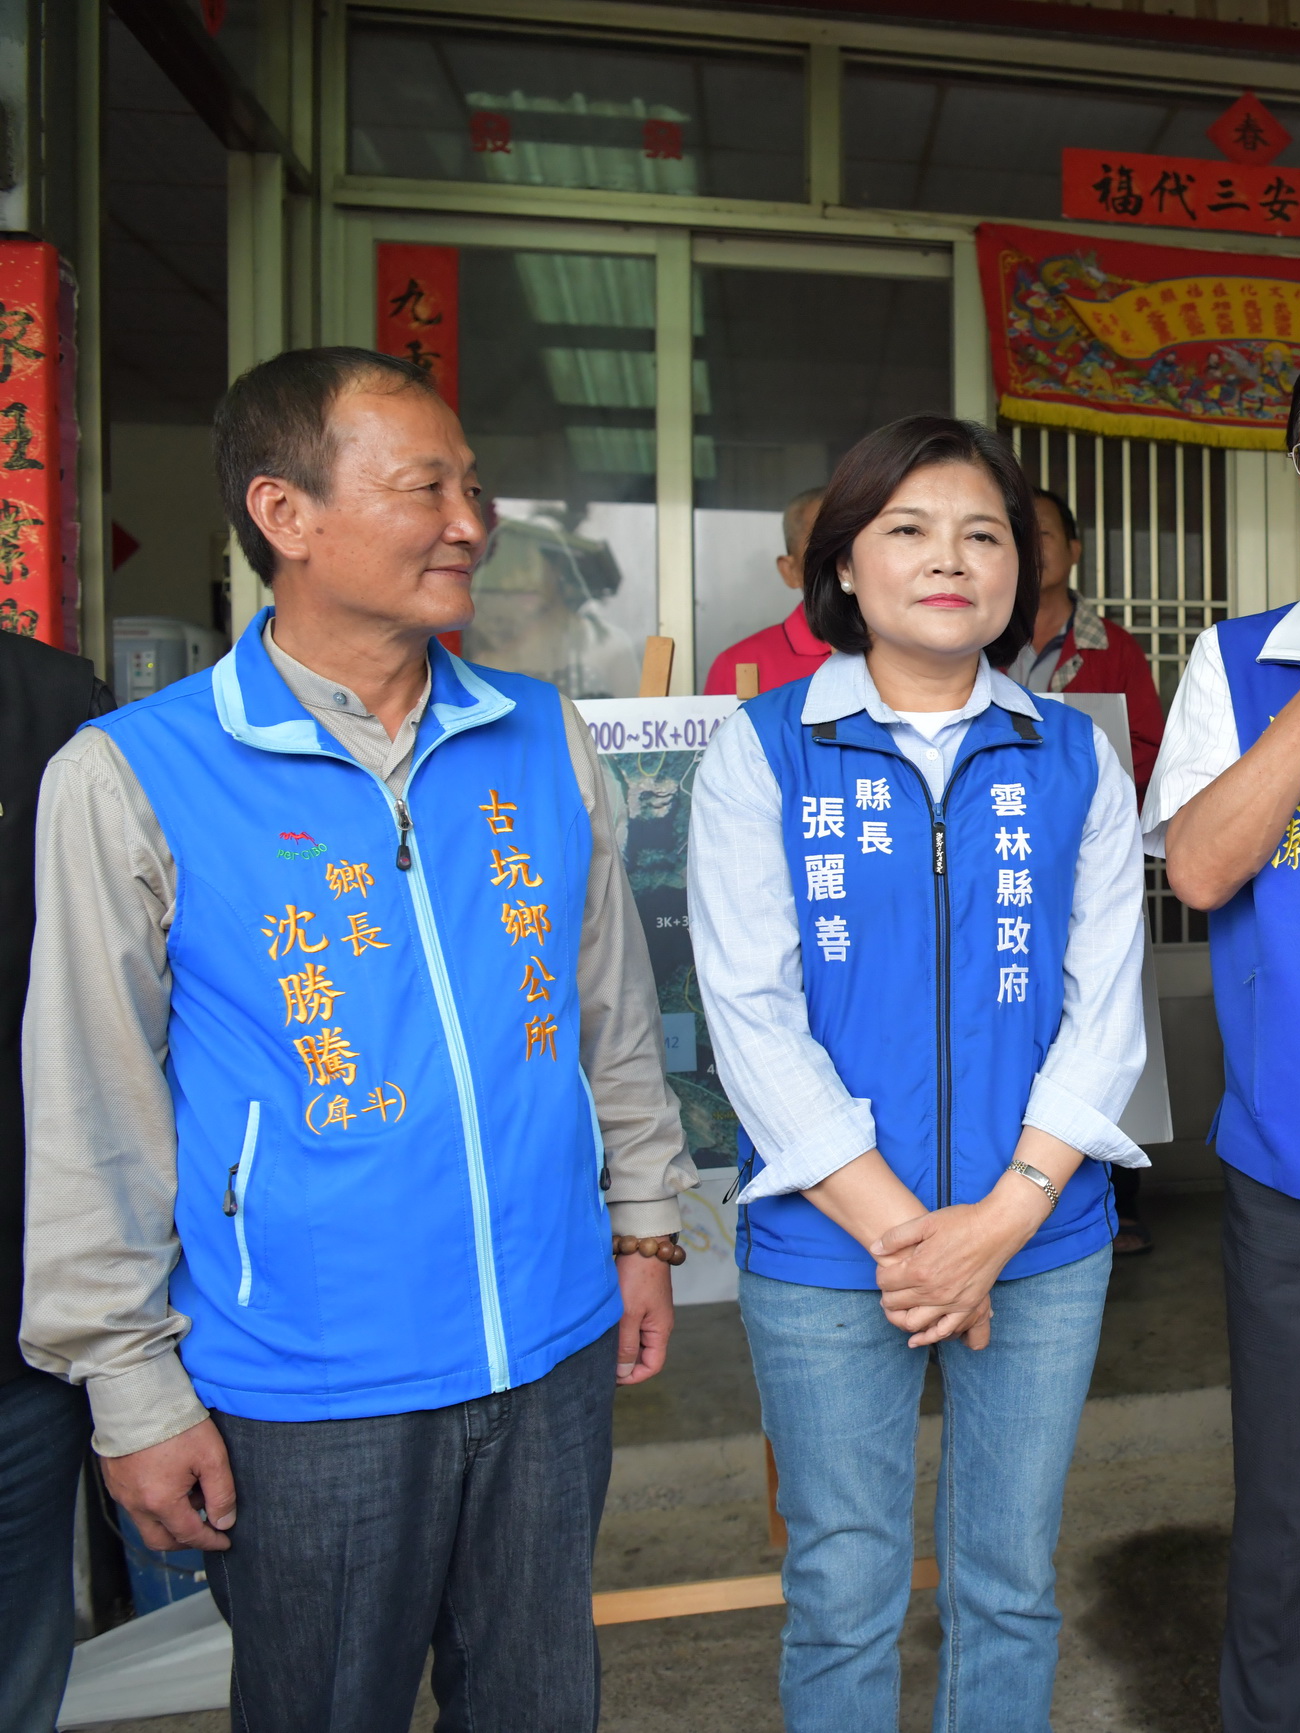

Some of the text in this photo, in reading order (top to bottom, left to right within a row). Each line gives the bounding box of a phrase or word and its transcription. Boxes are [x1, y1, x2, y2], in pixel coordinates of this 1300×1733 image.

[1231, 113, 1270, 152] 春
[802, 796, 851, 962] 張麗善
[856, 778, 894, 855] 縣長
[990, 783, 1034, 1003] 雲林縣政府
[325, 859, 392, 957] 鄉長
[478, 789, 558, 1062] 古坑鄉公所
[260, 904, 361, 1087] 沈勝騰
